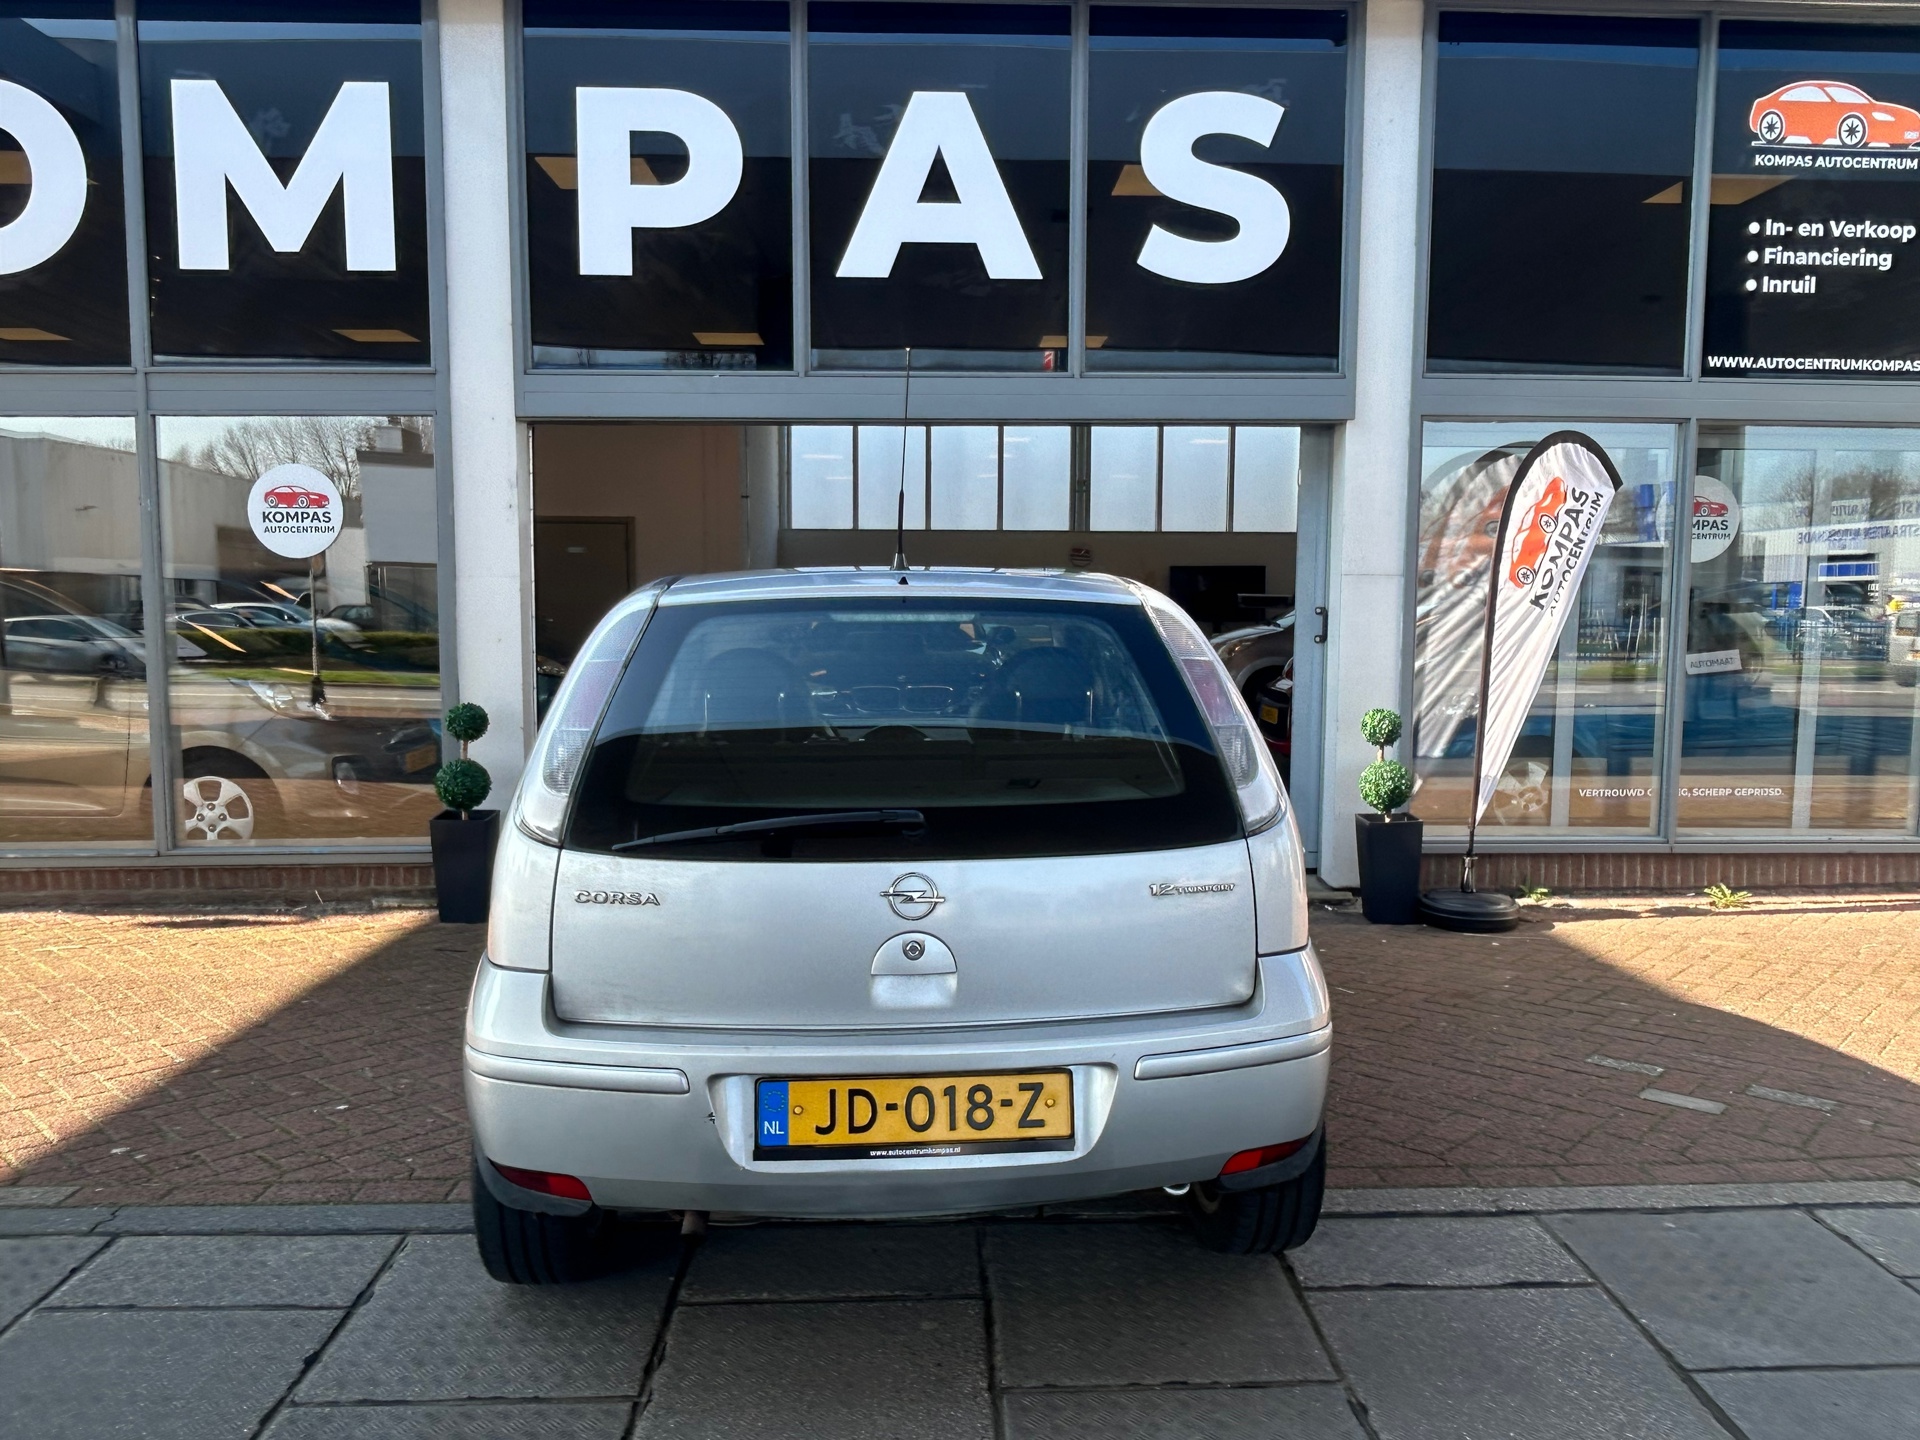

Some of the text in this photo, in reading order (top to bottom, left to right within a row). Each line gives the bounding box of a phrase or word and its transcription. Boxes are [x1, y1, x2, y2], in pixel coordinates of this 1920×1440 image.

[1754, 154, 1919, 170] KOMPAS AUTOCENTRUM
[1765, 219, 1917, 243] In- en Verkoop
[1763, 245, 1893, 271] Financiering
[1762, 275, 1817, 294] Inruil
[262, 511, 332, 523] KOMPAS
[264, 526, 335, 534] AUTOCENTRUM
[1529, 487, 1590, 610] KOMPAS
[1579, 788, 1645, 797] VERTROUWD
[1692, 788, 1733, 797] SCHERP
[573, 889, 661, 906] CORSA
[815, 1082, 1046, 1136] JD-018-Z
[763, 1120, 785, 1135] NL
